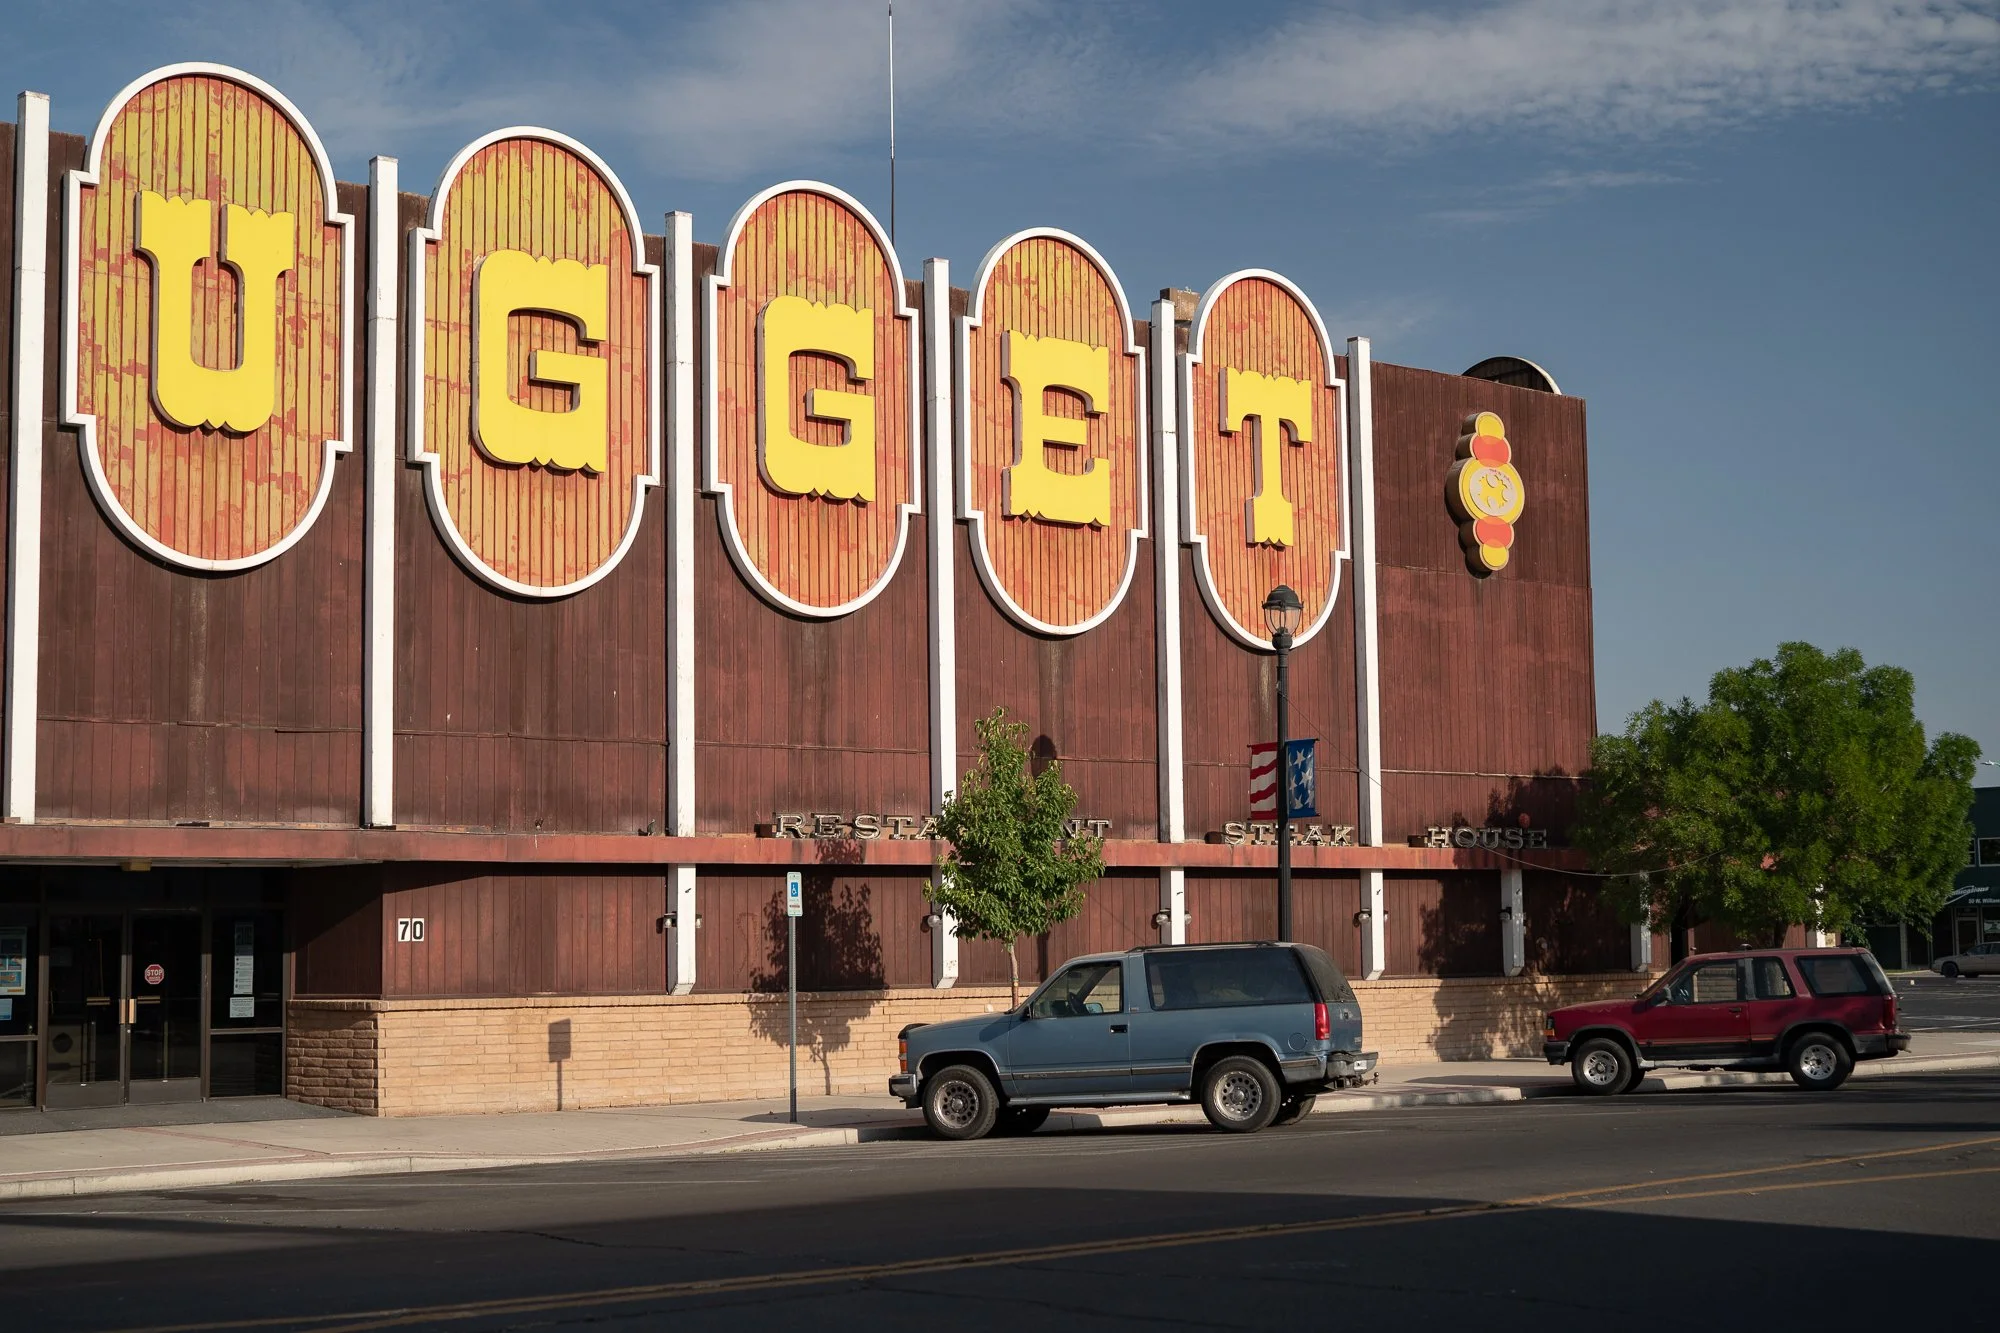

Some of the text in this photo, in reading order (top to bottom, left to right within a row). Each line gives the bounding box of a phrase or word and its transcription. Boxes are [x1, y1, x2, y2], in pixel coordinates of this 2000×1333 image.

[775, 813, 1113, 841] RESTANT
[1427, 826, 1548, 849] HOUSE
[400, 921, 423, 940] 70
